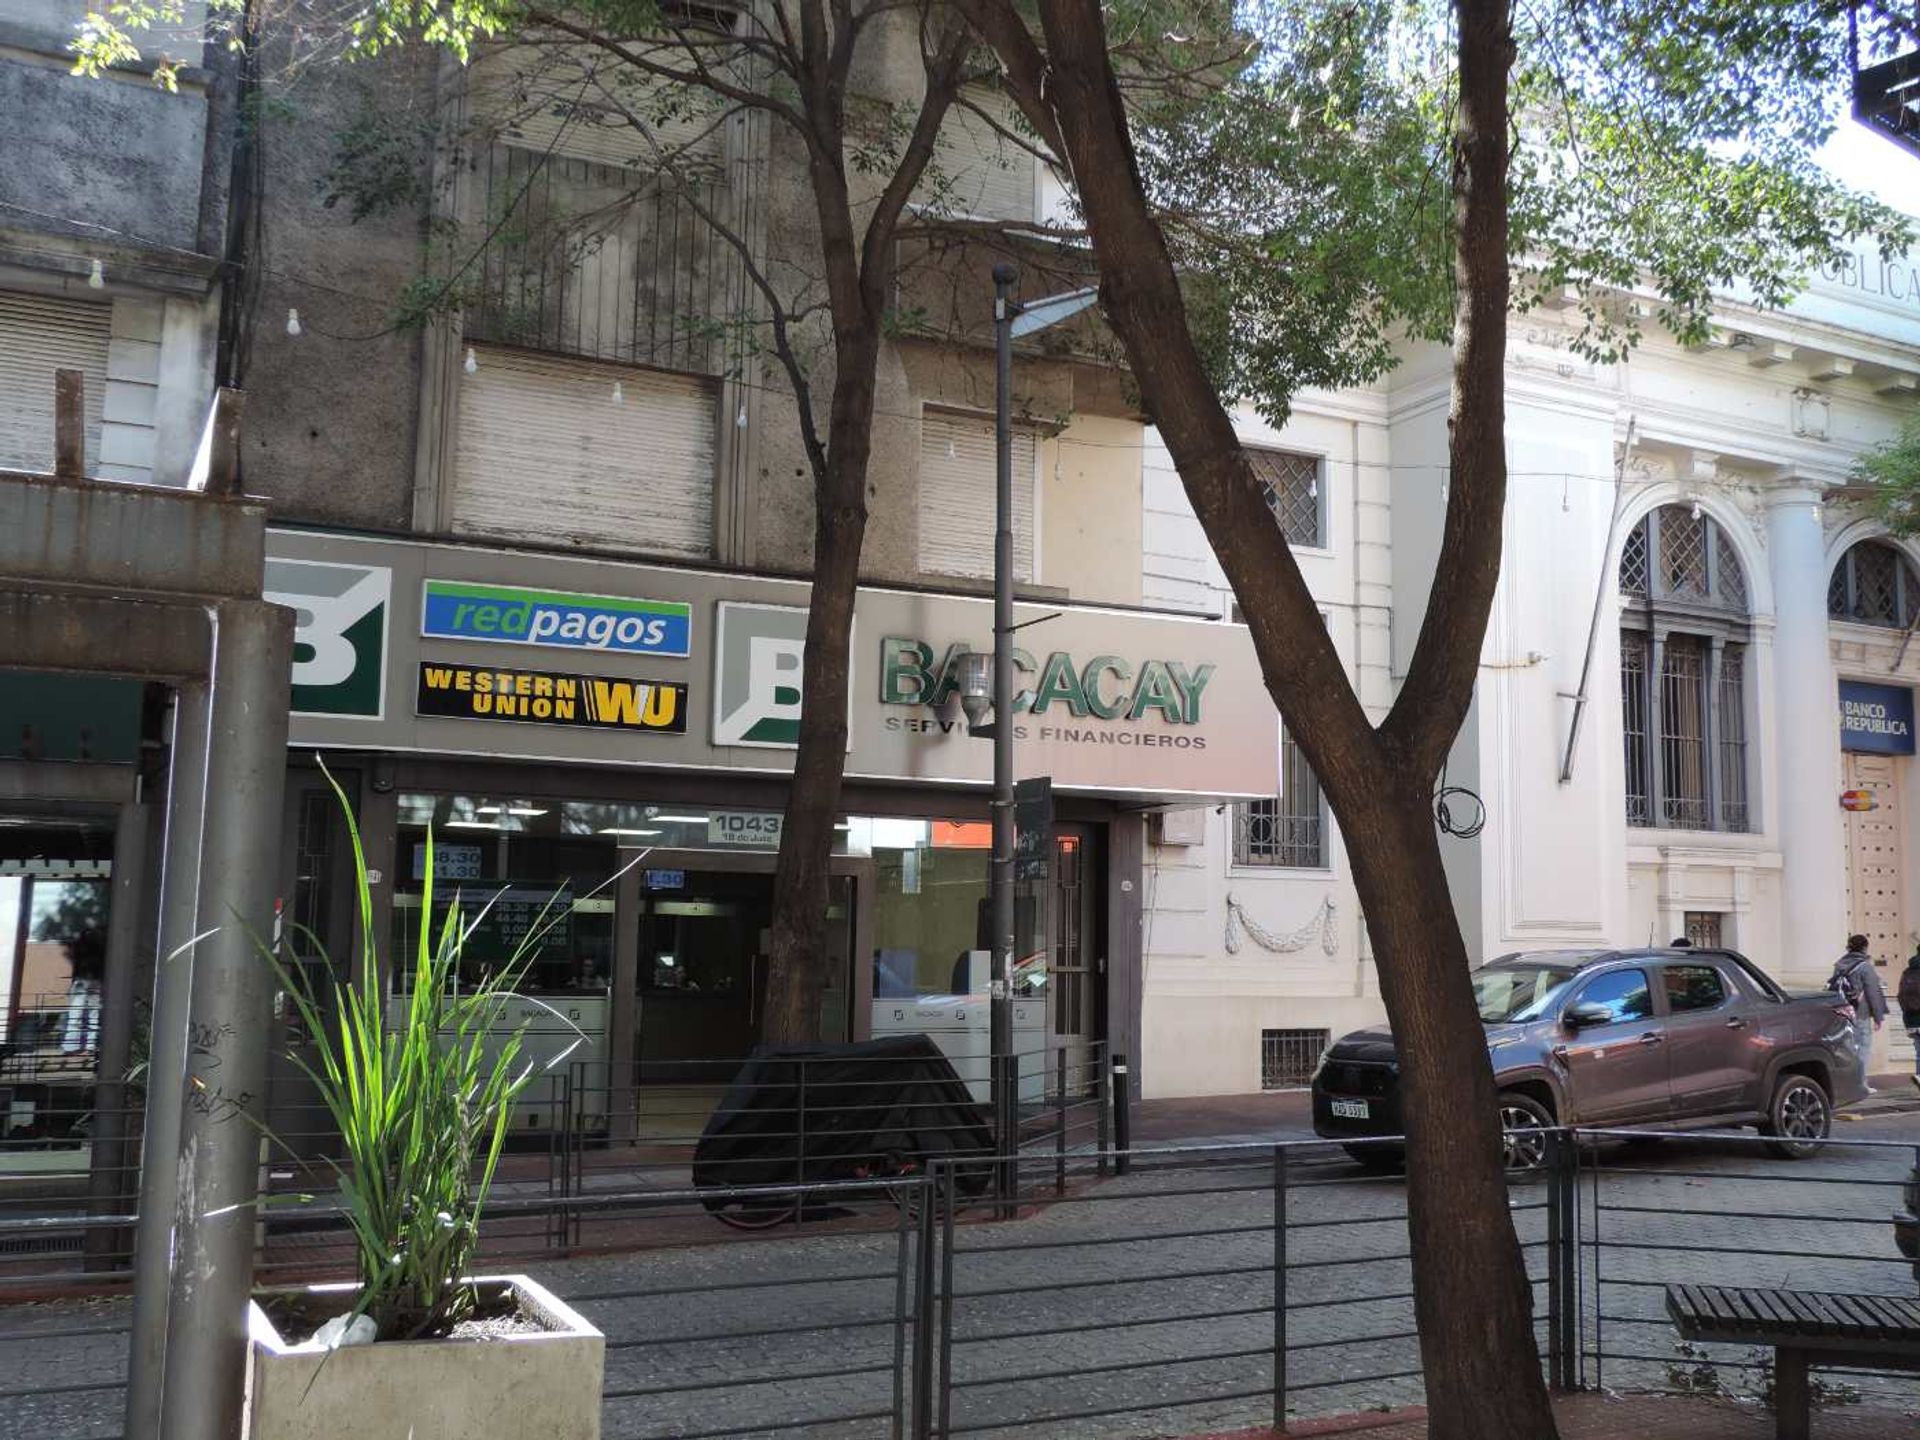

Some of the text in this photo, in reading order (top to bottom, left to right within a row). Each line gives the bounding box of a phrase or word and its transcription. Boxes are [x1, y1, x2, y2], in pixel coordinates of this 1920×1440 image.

[452, 601, 667, 648] redpagos
[424, 667, 576, 698] WESTERN
[472, 693, 575, 720] UNION
[594, 680, 676, 728] WU
[1845, 701, 1886, 718] BANCO
[884, 716, 1208, 749] SERVIS FINANCIEROS
[716, 815, 779, 834] 1043
